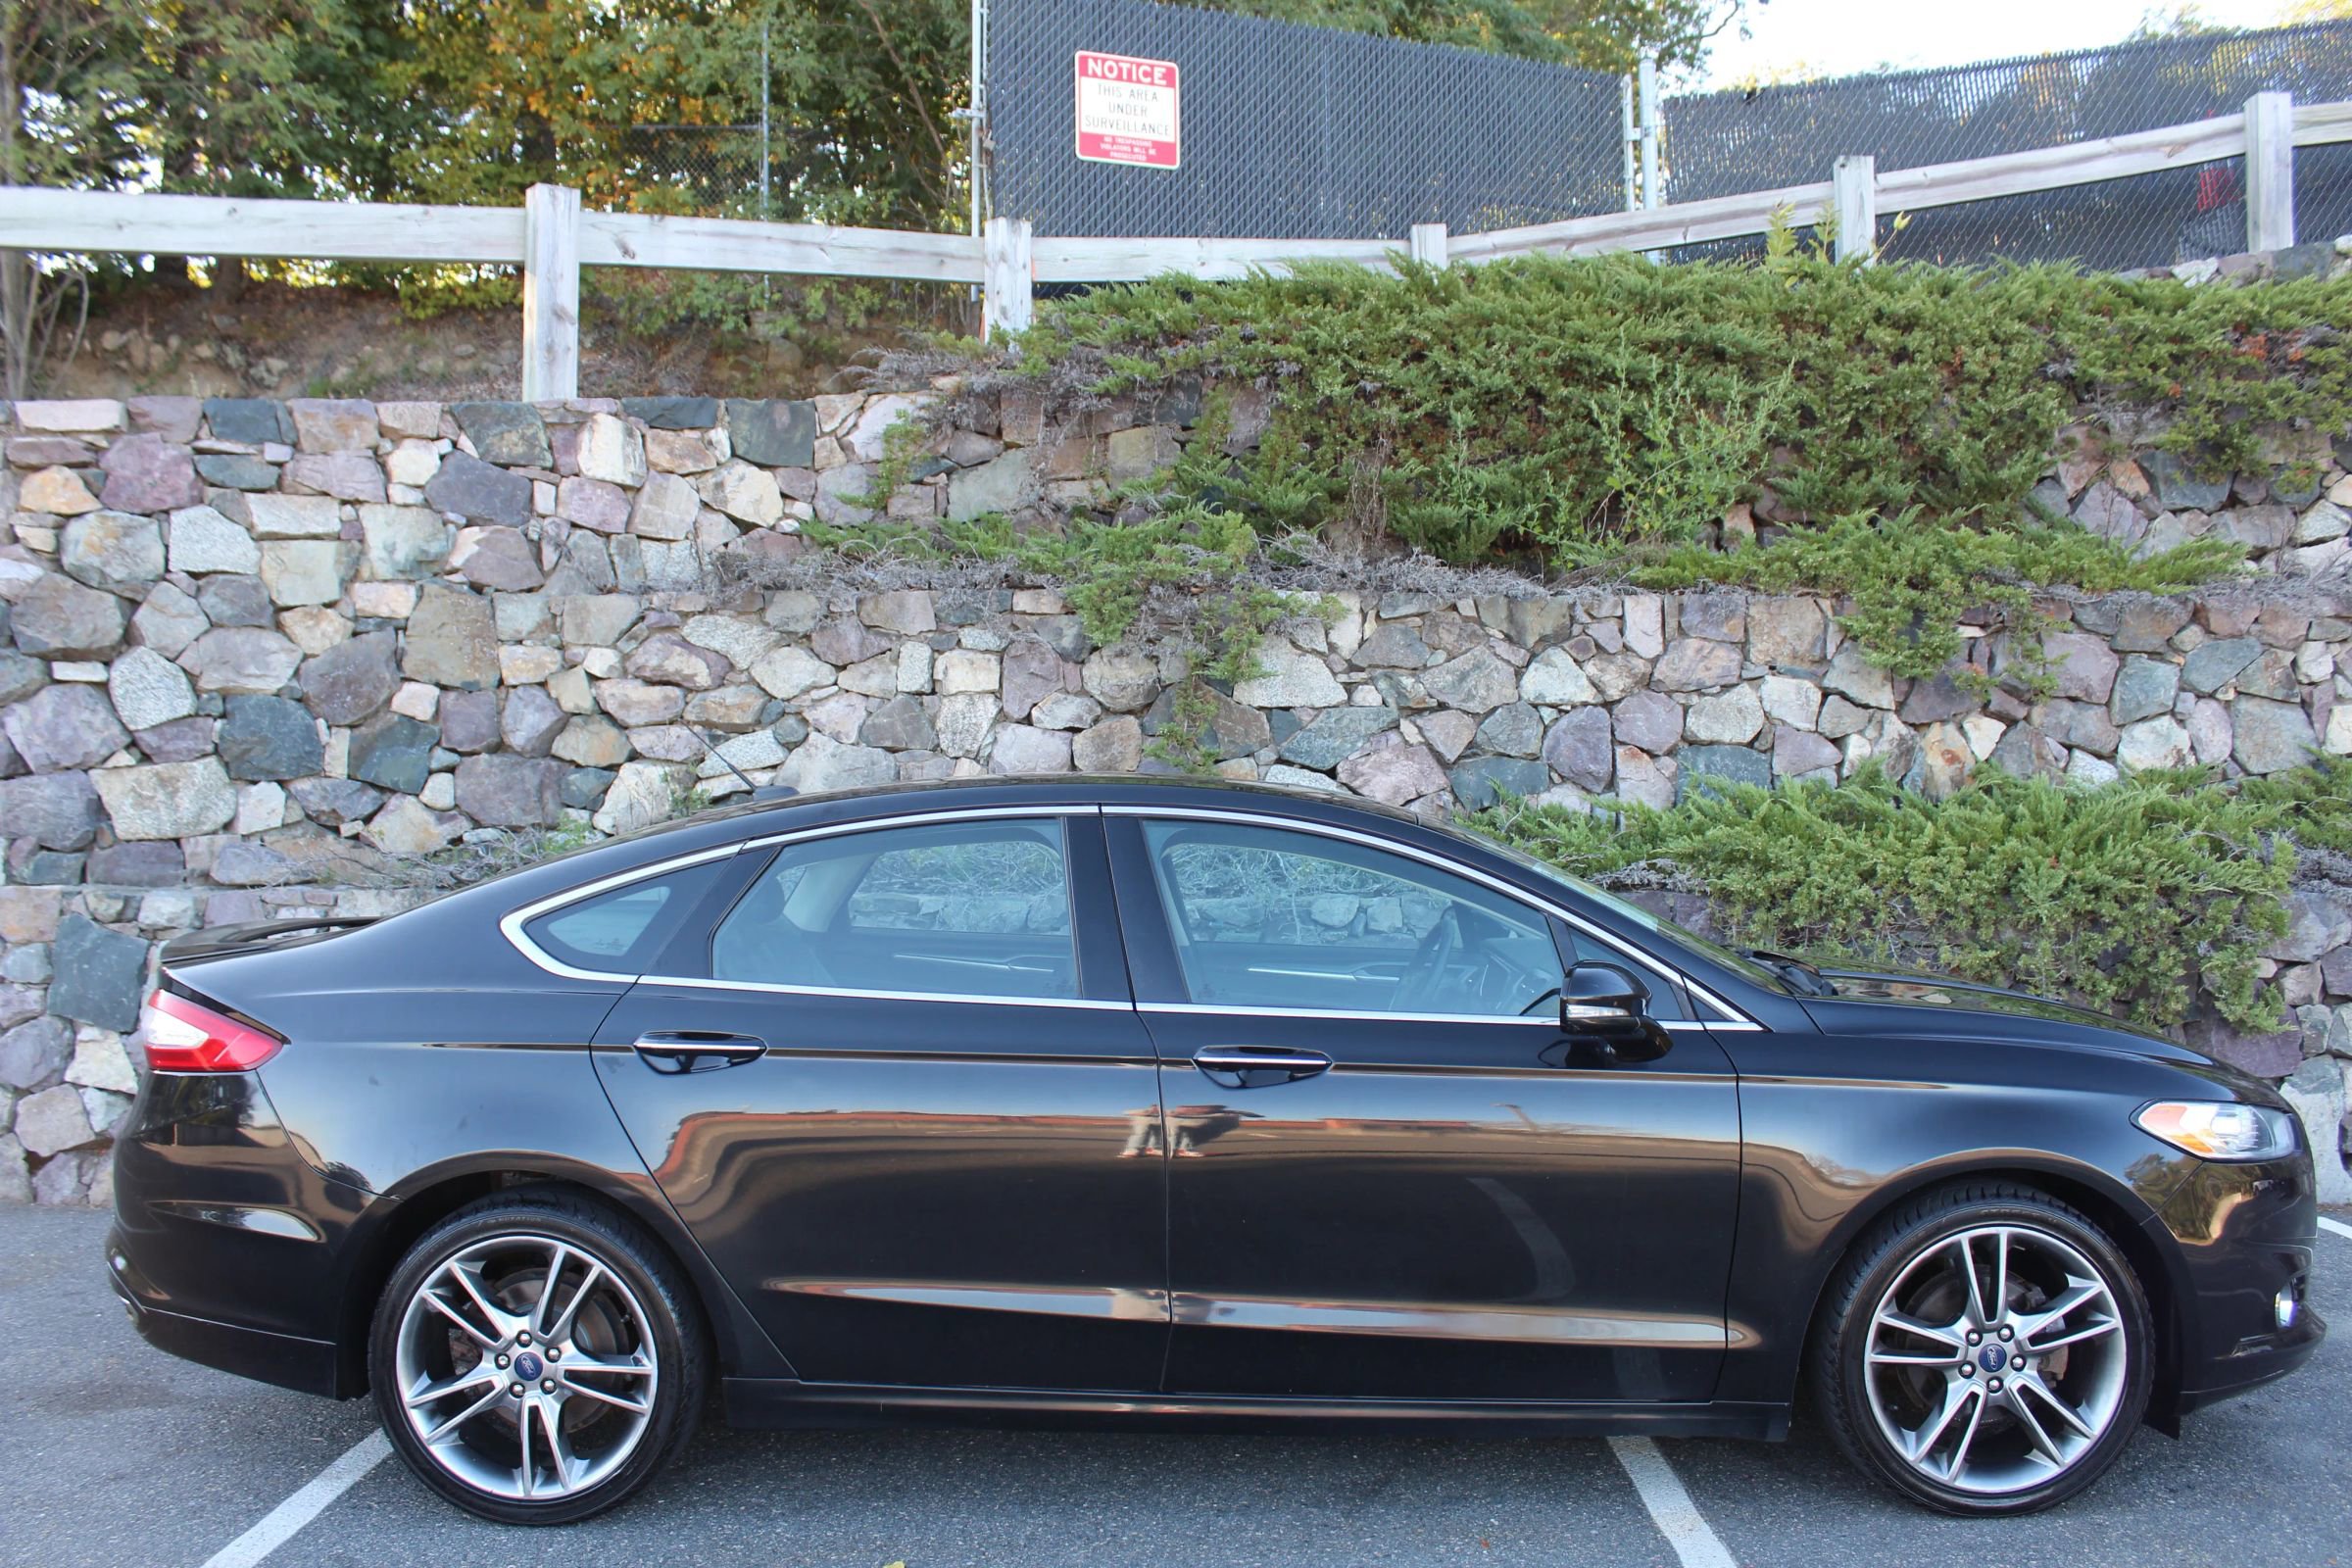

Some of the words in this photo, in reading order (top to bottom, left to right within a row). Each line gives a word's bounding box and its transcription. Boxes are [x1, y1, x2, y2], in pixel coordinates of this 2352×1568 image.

[1088, 58, 1167, 85] NOTICE
[1098, 83, 1122, 98] THIS
[1129, 88, 1158, 102] AREA
[1108, 102, 1148, 118] UNDER
[1085, 115, 1169, 135] SURVEILLANCE
